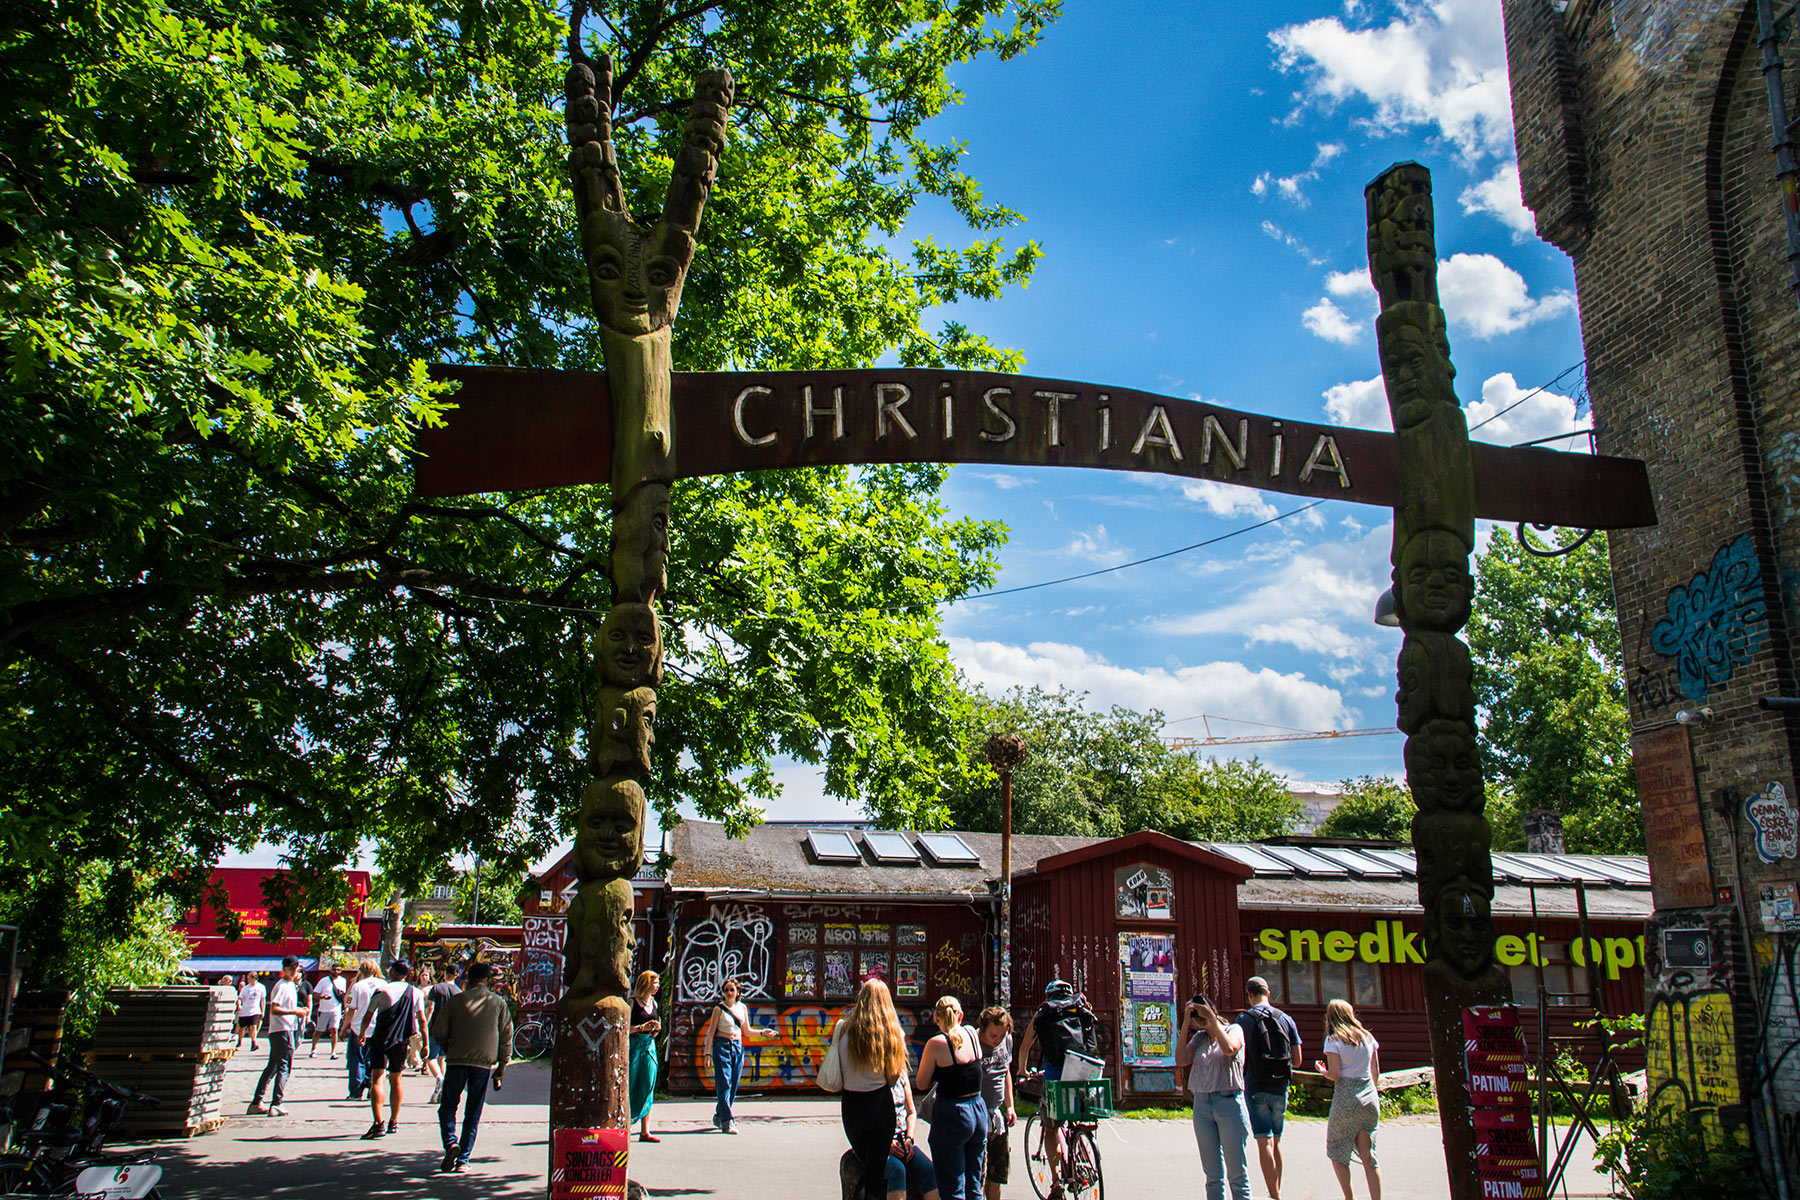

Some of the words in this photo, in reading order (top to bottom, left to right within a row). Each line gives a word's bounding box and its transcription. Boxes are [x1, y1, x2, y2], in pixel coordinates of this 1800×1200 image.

[1258, 920, 1550, 968] snedket
[1143, 1013, 1162, 1021] FEST
[1472, 1075, 1511, 1092] PATINA
[565, 1151, 613, 1168] SØNDAGS
[565, 1168, 612, 1182] KONCERTER
[1483, 1180, 1523, 1199] PATINA
